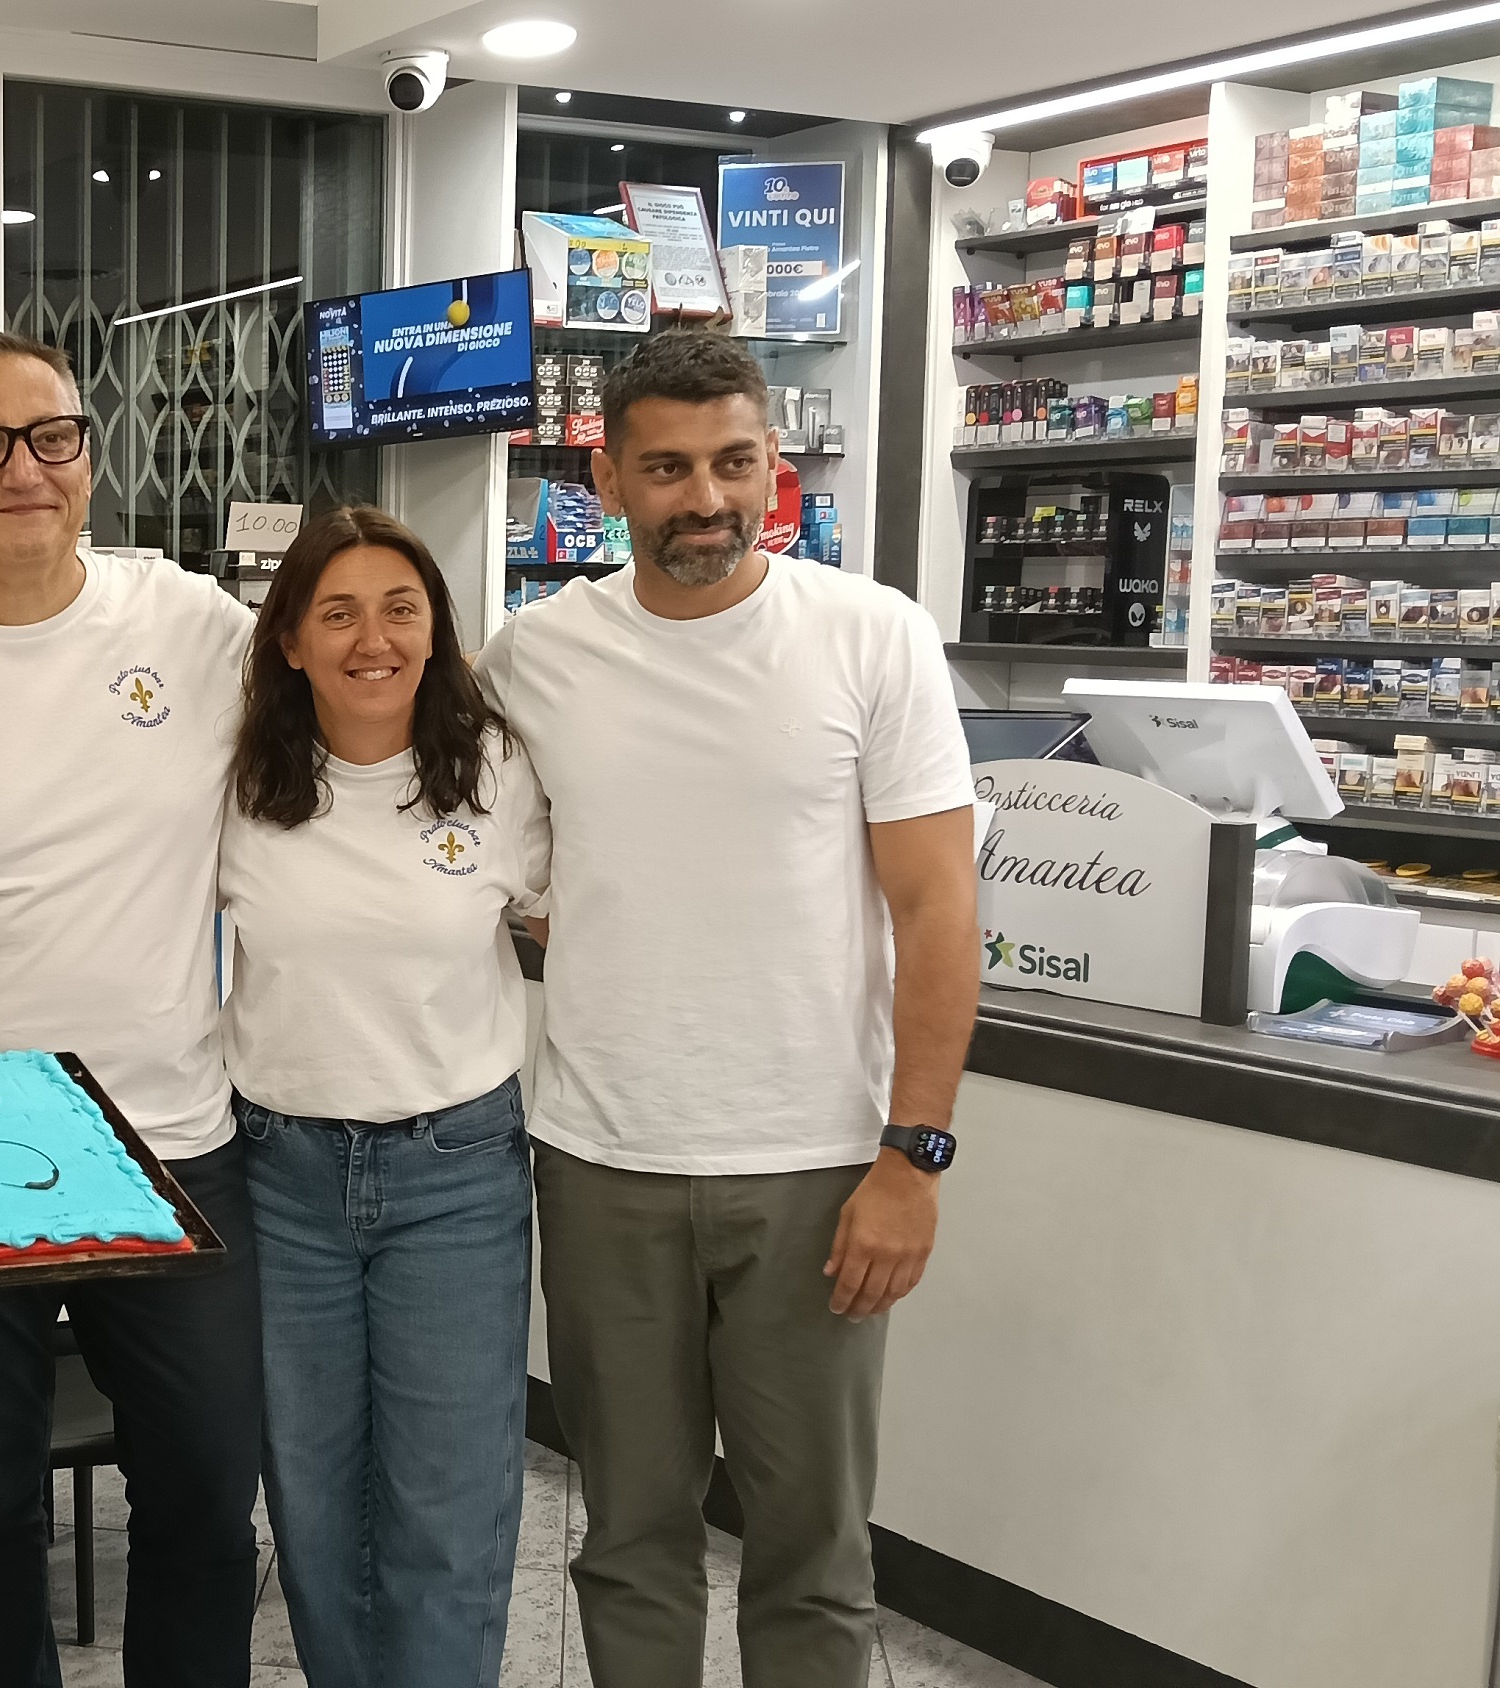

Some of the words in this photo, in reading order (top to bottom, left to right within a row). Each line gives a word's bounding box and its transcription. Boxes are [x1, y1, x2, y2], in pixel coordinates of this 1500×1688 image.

[1189, 149, 1206, 158] virto
[1120, 200, 1132, 210] glo
[728, 209, 788, 228] VINTI
[795, 208, 835, 228] QUI
[627, 297, 645, 308] VELO
[319, 306, 347, 320] NOVITÀ
[373, 335, 424, 354] NUOVA
[425, 321, 513, 346] DIMENSIONE
[392, 326, 421, 338] ENTRA
[423, 324, 433, 334] IN
[457, 342, 468, 352] DI
[469, 338, 500, 351] GIOCO
[537, 365, 560, 376] OCB
[574, 366, 598, 377] OCB
[538, 395, 561, 406] OCB
[578, 396, 601, 406] OCB
[370, 408, 426, 426] BRILLANTE.
[427, 403, 475, 419] INTENSO.
[476, 396, 532, 413] PREZIOSO.
[538, 425, 561, 435] OCB
[1124, 499, 1163, 514] RELX
[236, 513, 297, 533] 10.00
[564, 534, 596, 548] OCB
[752, 522, 795, 547] Smoking
[121, 706, 171, 728] Amantea
[1166, 718, 1199, 730] Sisal
[974, 776, 1123, 821] Pasticceria
[423, 858, 478, 876] Amantea
[980, 829, 1152, 897] Amantea
[1018, 944, 1090, 983] Sisal
